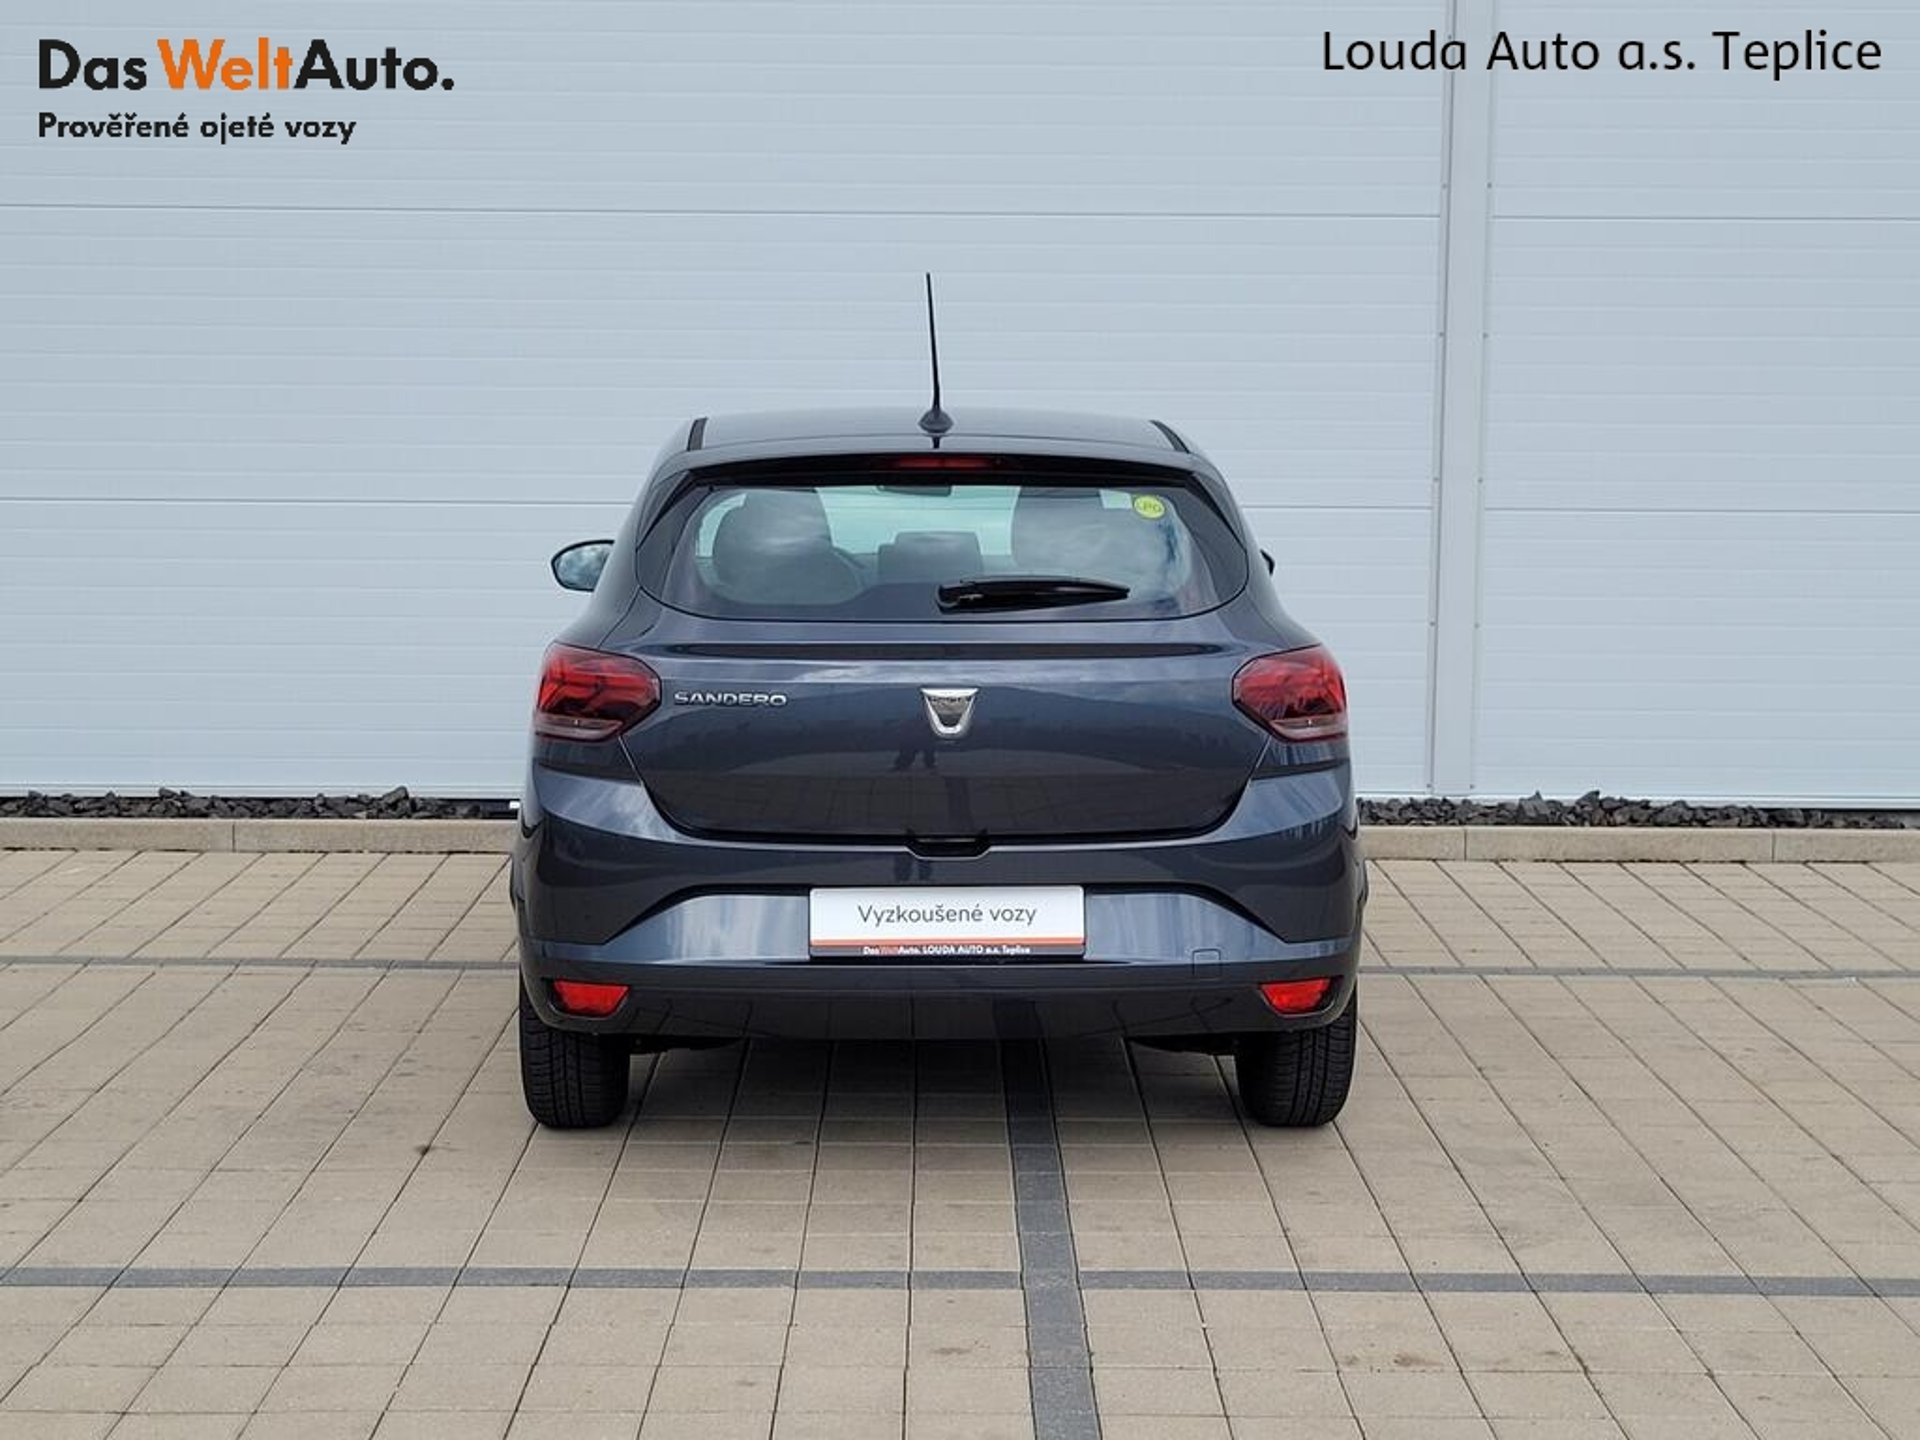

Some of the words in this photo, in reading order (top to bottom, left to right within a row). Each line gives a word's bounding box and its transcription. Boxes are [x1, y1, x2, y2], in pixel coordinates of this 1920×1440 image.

[674, 691, 787, 706] SANDERO
[858, 904, 983, 927] Vyzkoušené
[990, 907, 1037, 925] vozy
[922, 945, 955, 954] LOUDA
[957, 945, 983, 954] AUTO
